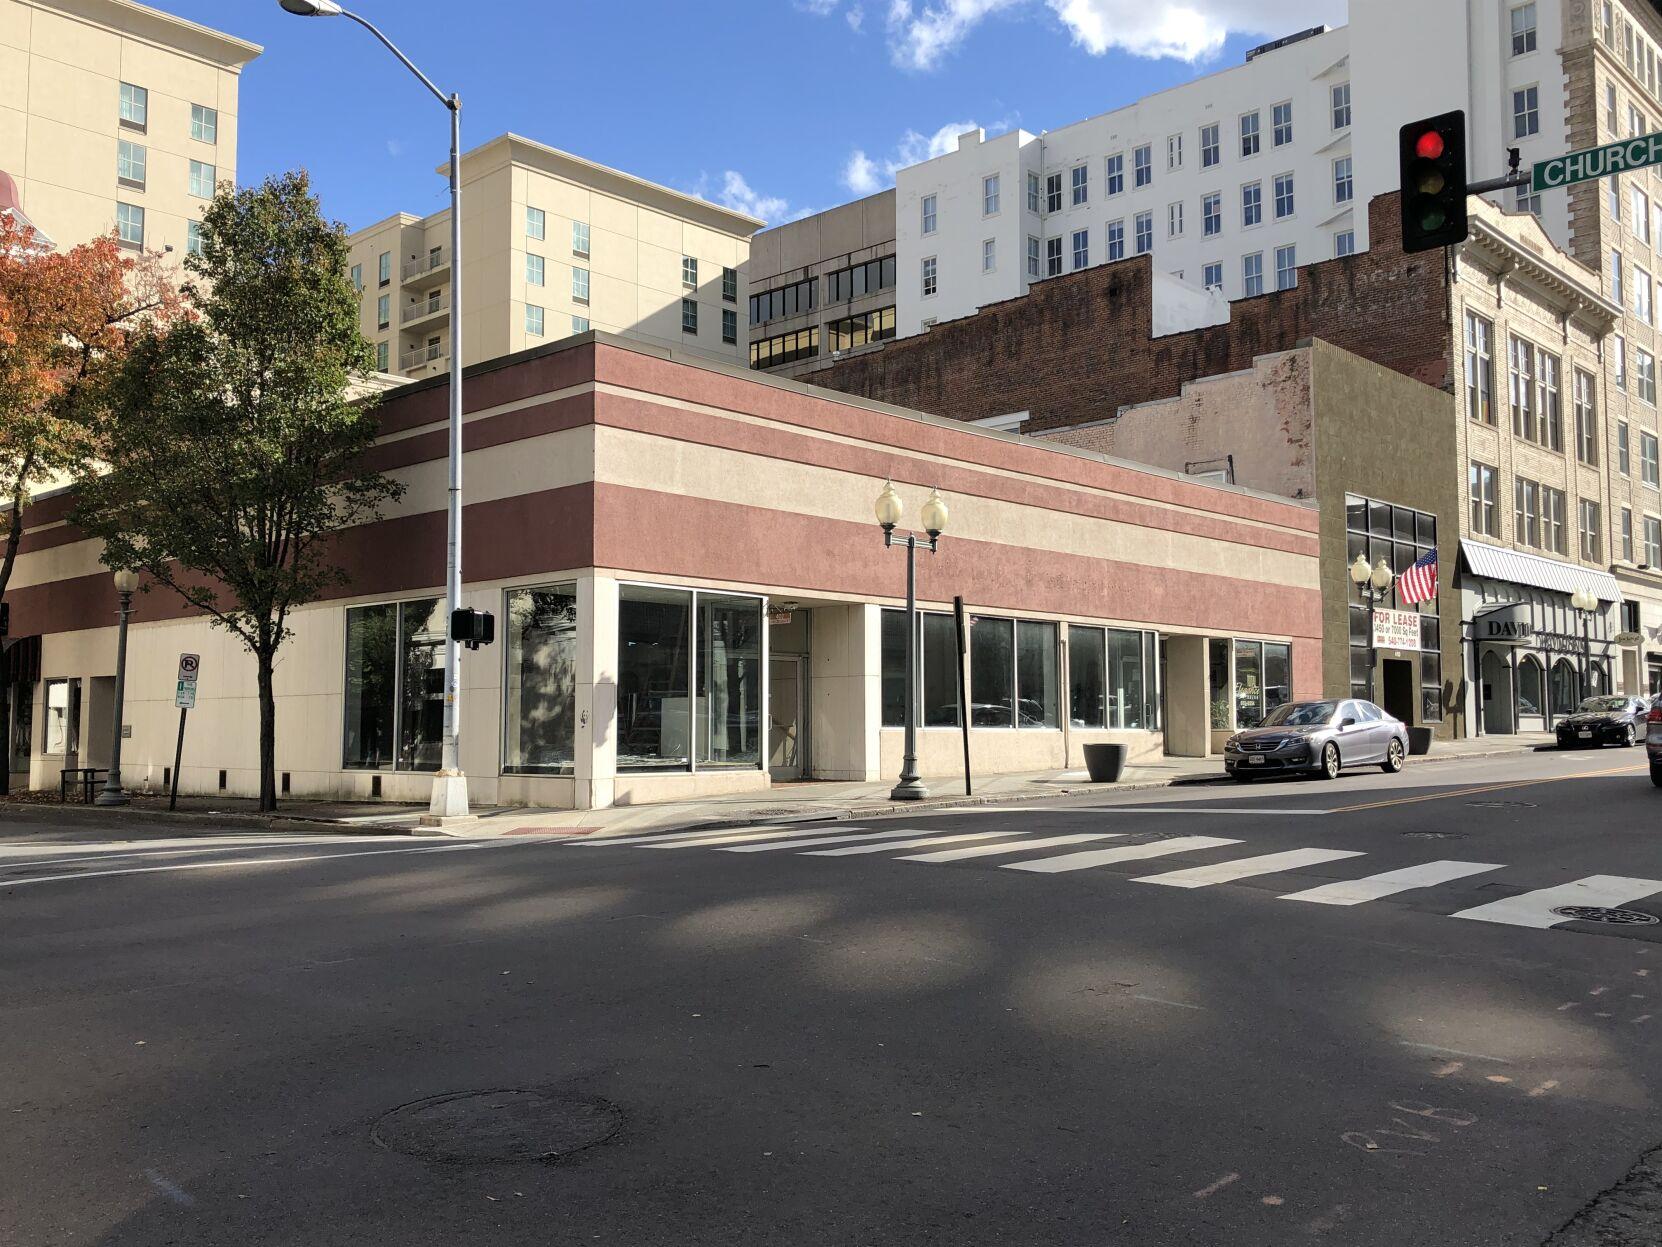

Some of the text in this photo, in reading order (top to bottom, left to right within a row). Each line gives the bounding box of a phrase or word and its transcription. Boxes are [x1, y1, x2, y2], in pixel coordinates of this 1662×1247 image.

[1544, 138, 1662, 185] CHURCH
[1374, 612, 1417, 627] FOR LEASE
